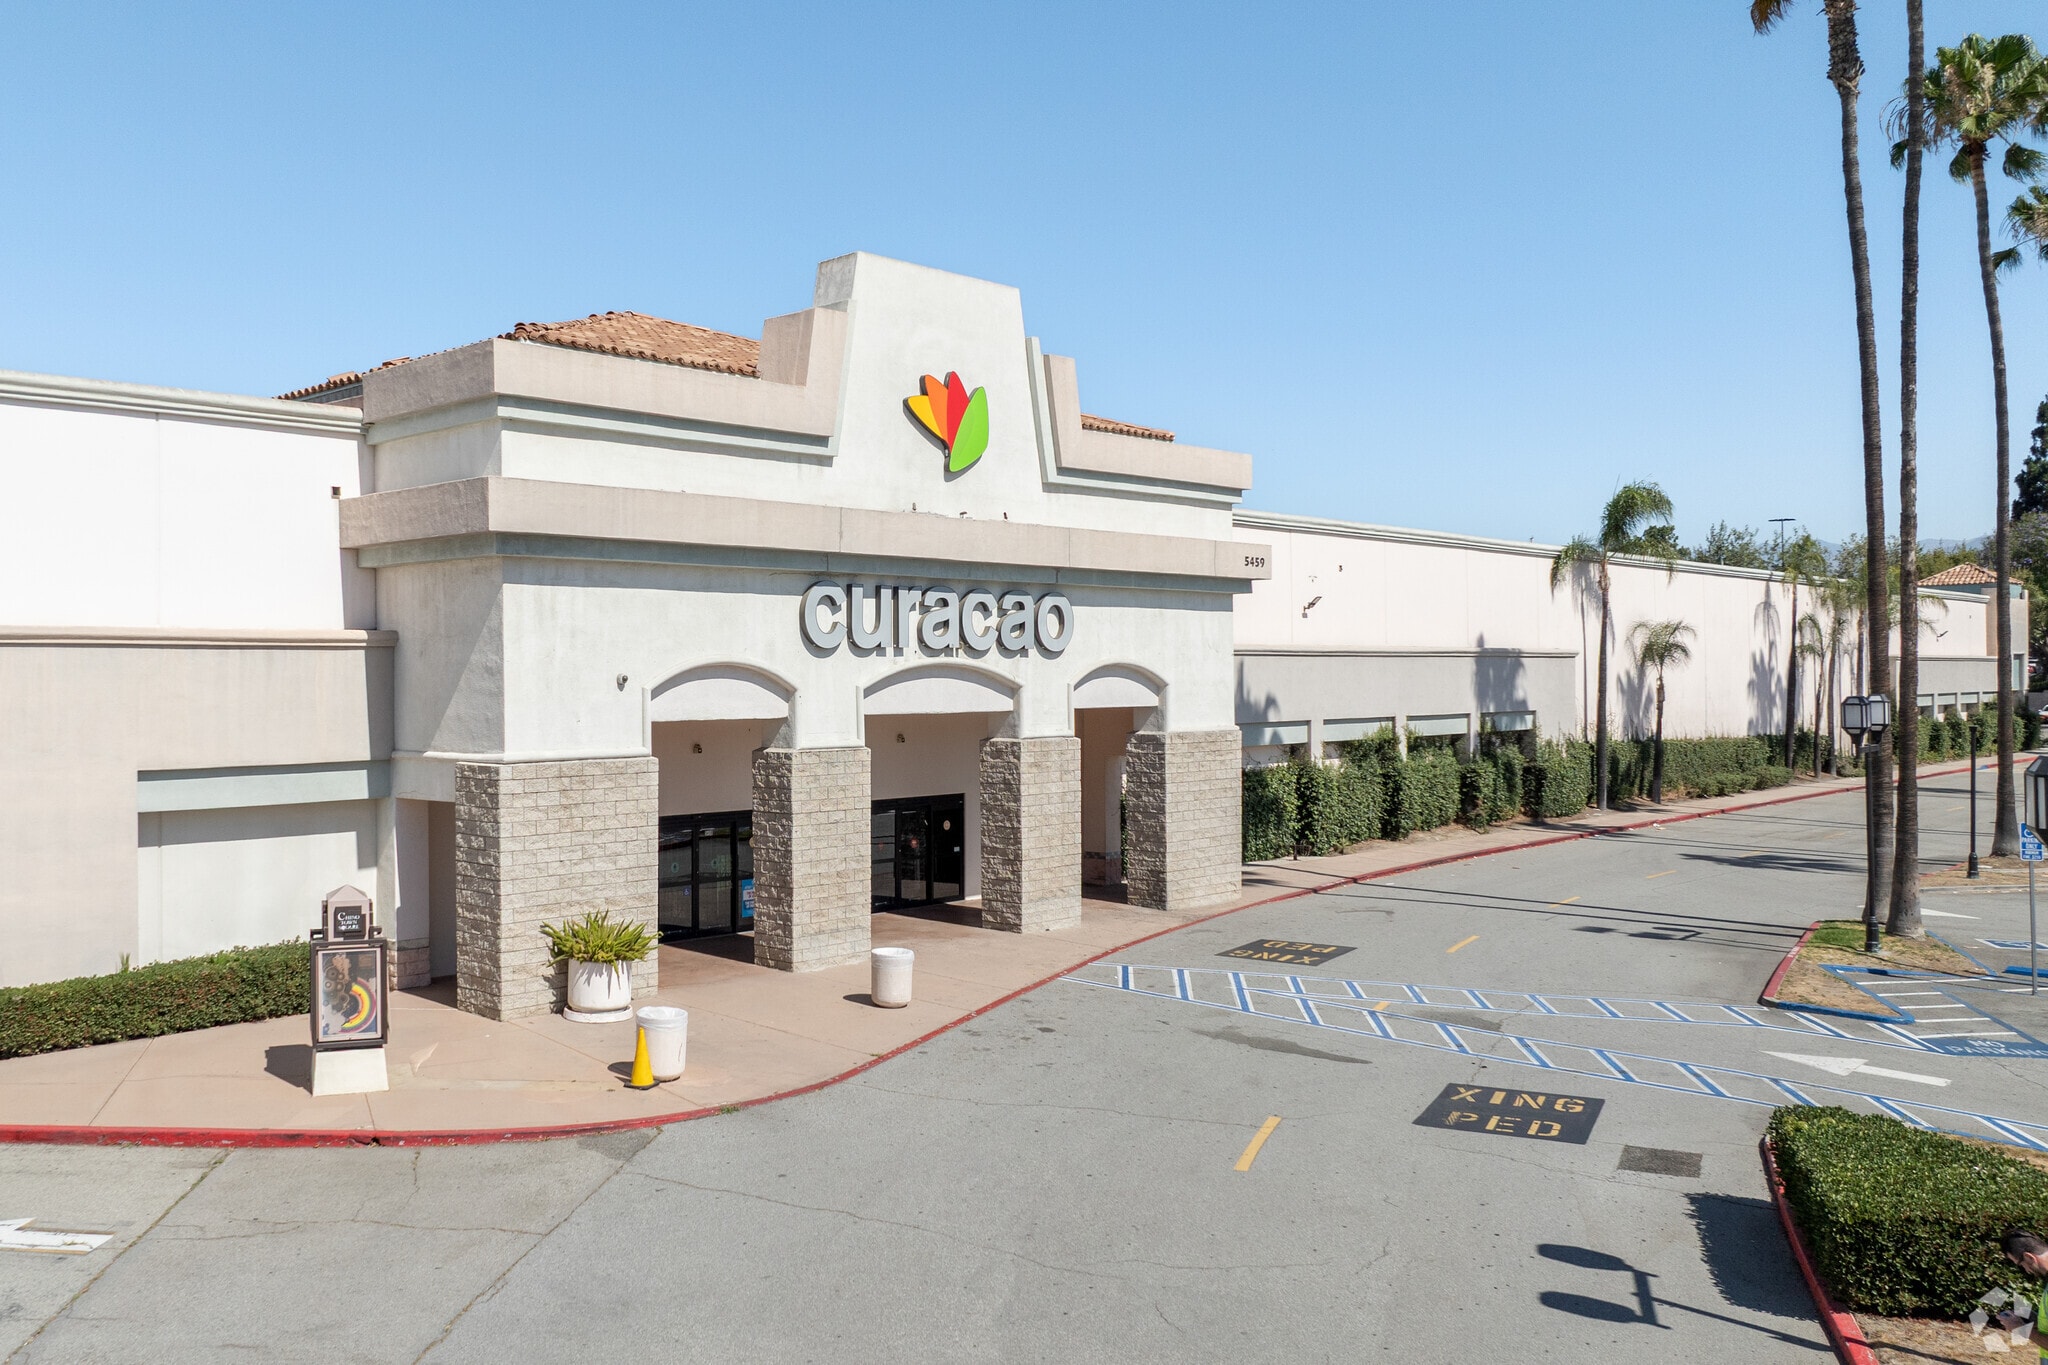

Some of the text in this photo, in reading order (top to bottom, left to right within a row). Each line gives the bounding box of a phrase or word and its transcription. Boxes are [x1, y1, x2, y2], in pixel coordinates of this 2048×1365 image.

[1244, 556, 1265, 568] 5459
[800, 580, 1075, 652] curacao
[1262, 940, 1338, 954] PED
[1228, 949, 1321, 965] XING
[1967, 1040, 2006, 1048] NO
[1450, 1086, 1586, 1113] XING
[1443, 1111, 1563, 1138] PED
